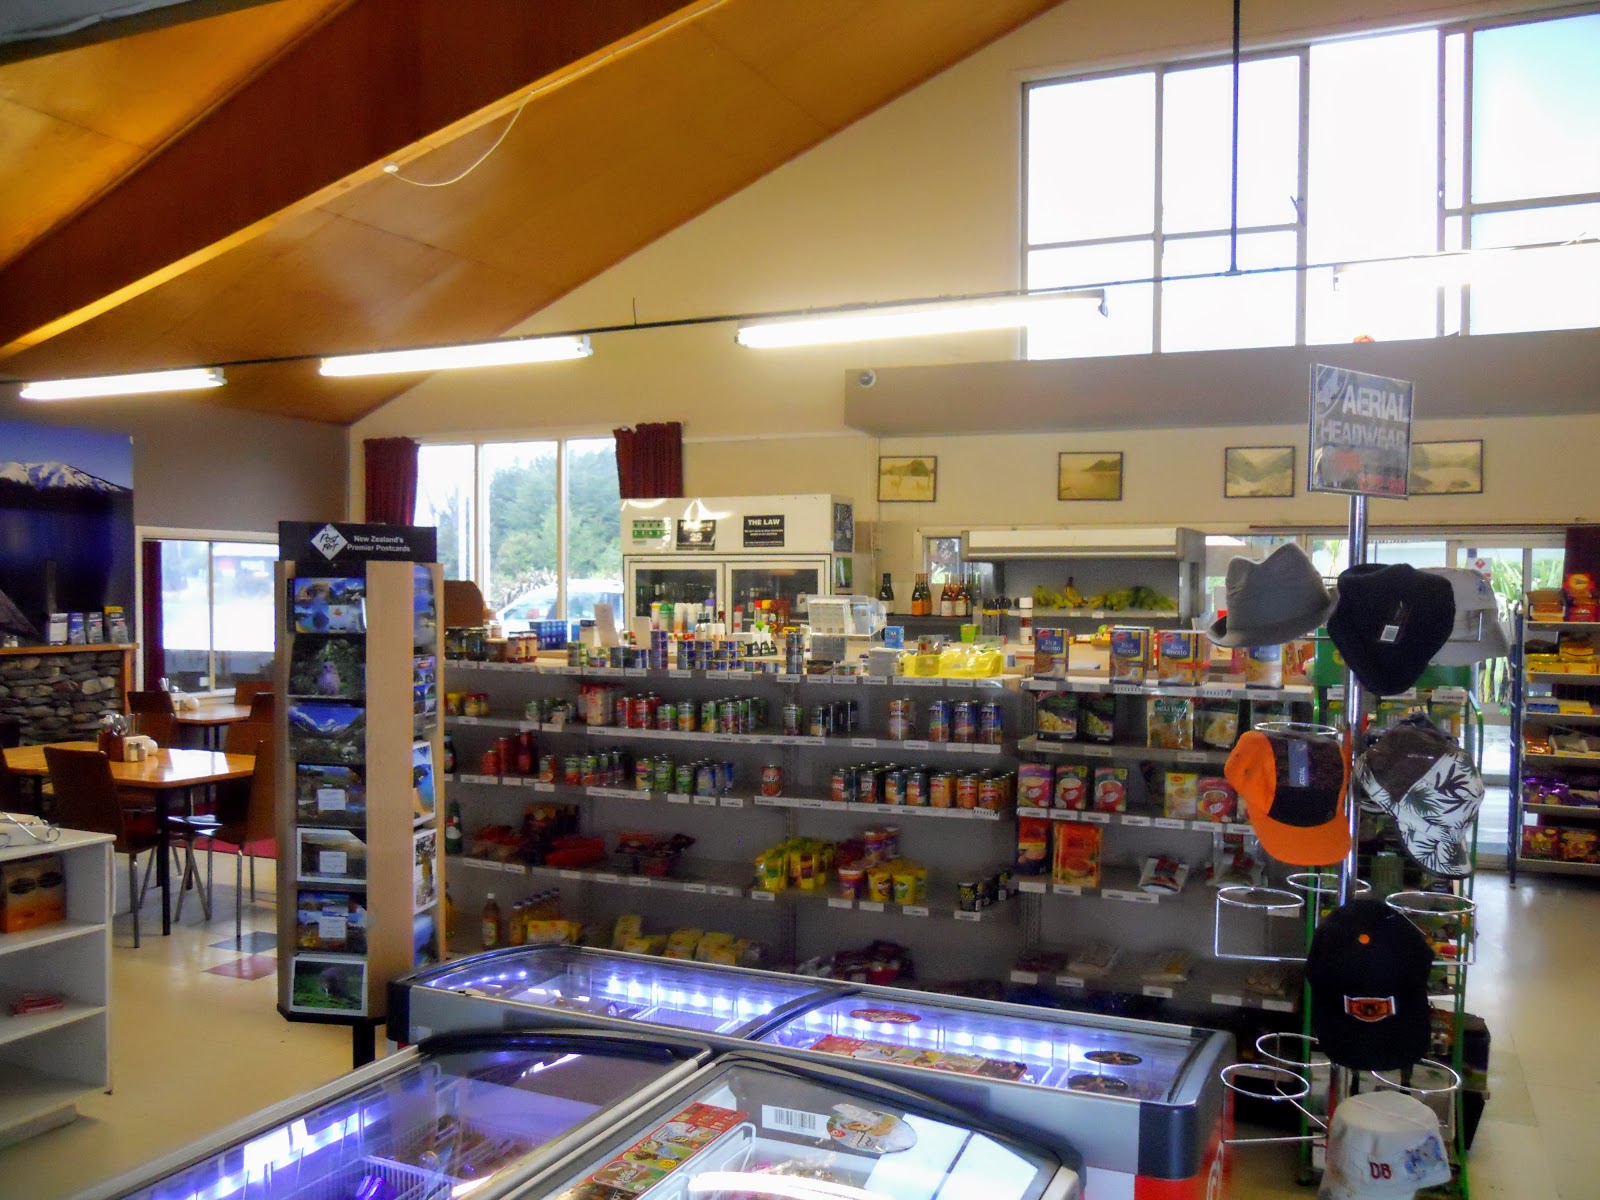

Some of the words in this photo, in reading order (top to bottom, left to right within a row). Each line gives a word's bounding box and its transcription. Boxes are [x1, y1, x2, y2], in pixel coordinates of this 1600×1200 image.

[1342, 385, 1410, 423] AERIAL
[370, 535, 404, 543] Zealand's
[347, 543, 375, 551] Premier
[376, 544, 411, 552] Postcards
